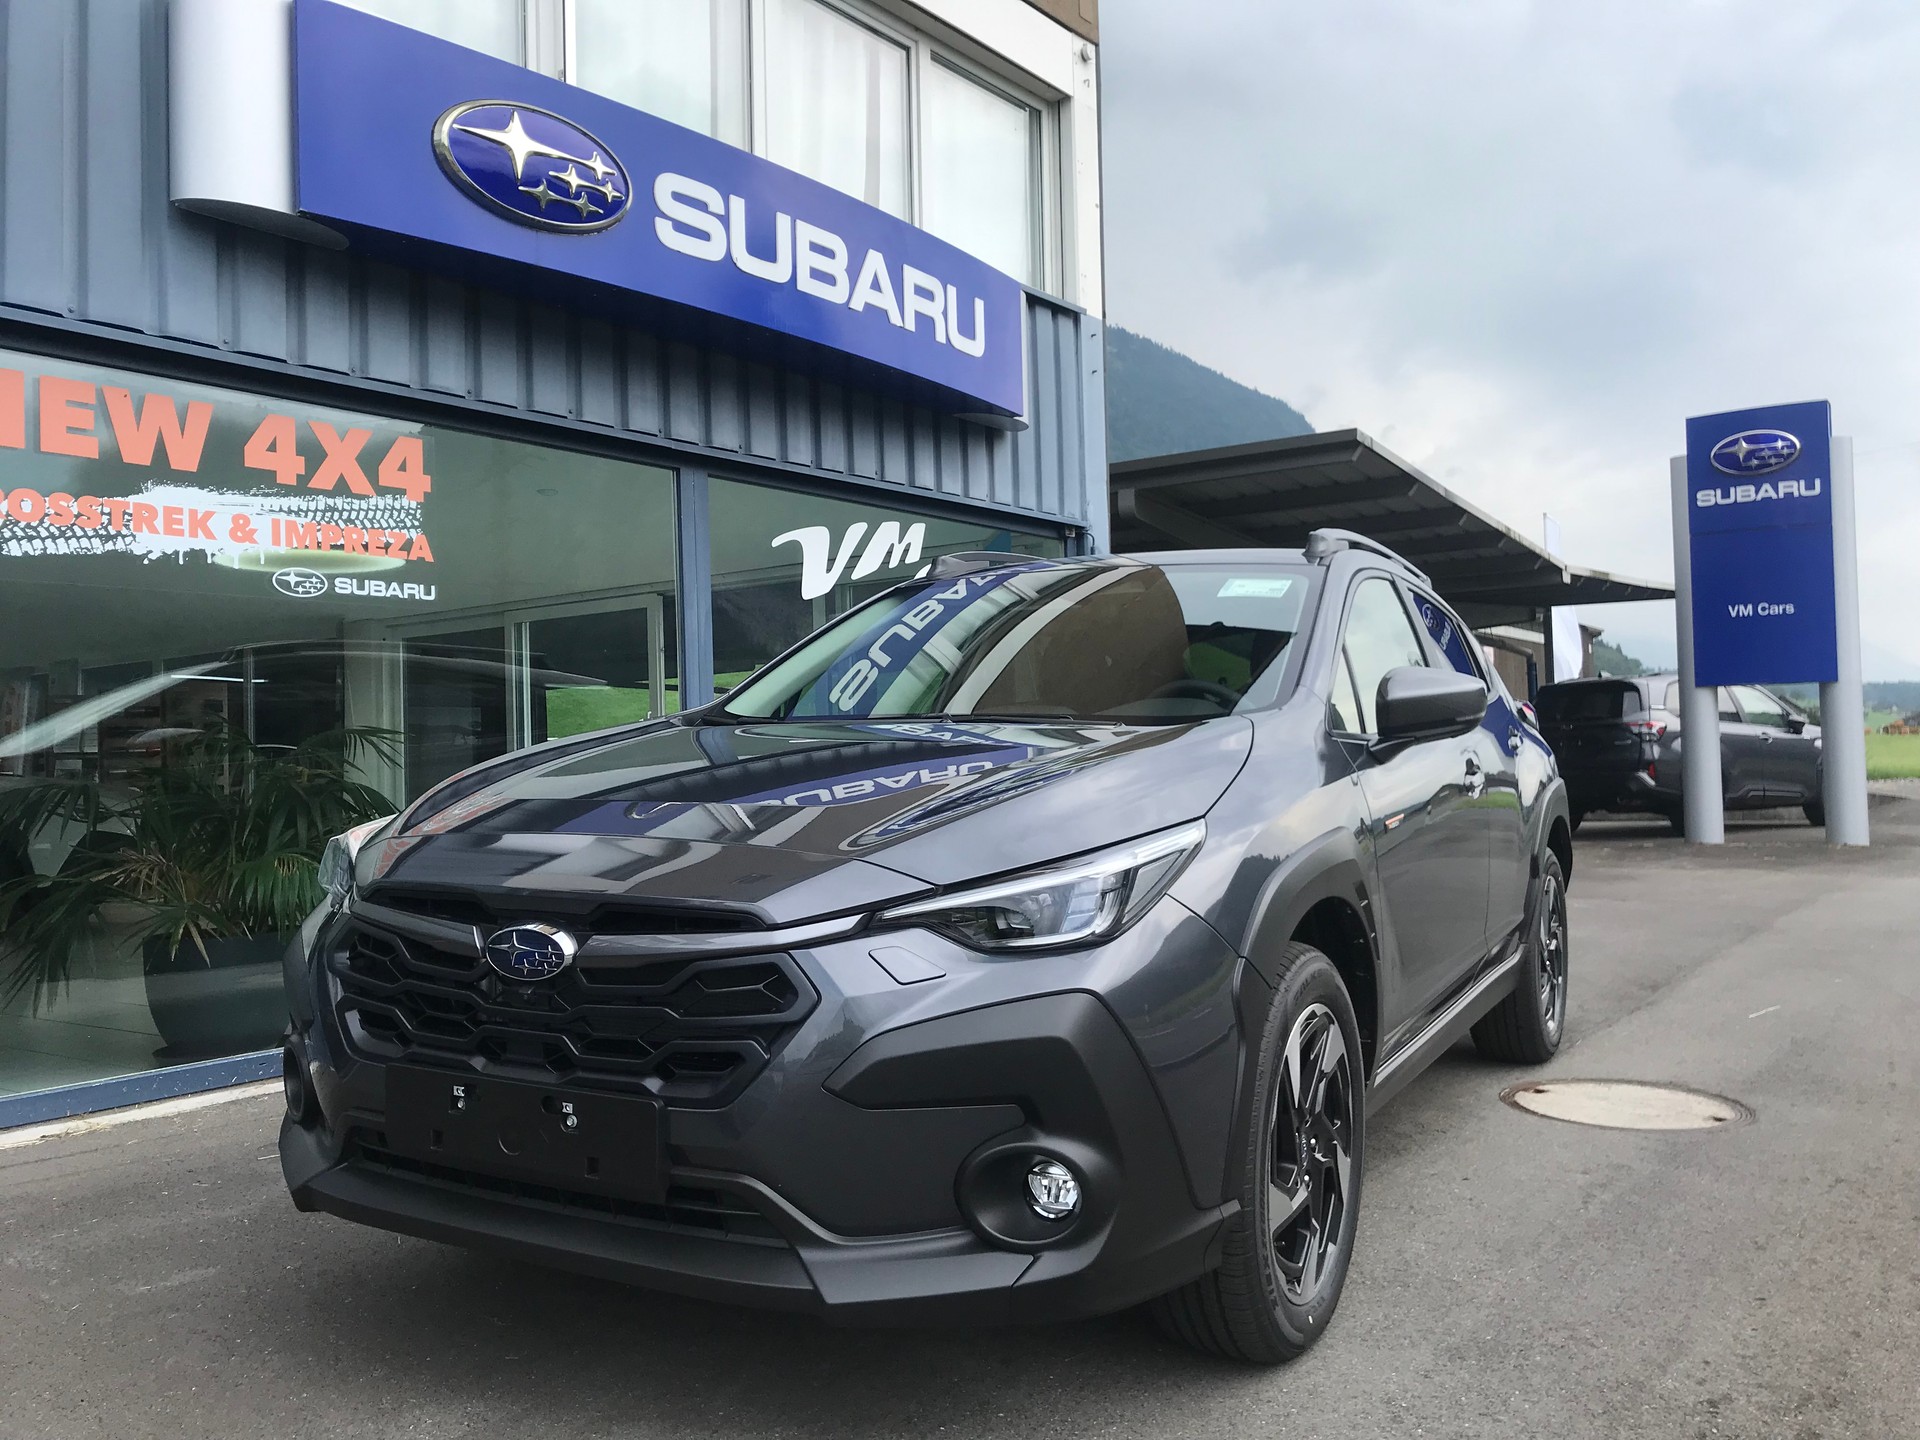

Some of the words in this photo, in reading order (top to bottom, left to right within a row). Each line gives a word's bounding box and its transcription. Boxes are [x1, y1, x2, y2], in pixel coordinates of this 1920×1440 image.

[653, 172, 985, 358] SUBARU
[243, 414, 431, 503] 4X4
[1696, 478, 1821, 508] SUBARU
[0, 488, 217, 541] OSSTREK
[228, 513, 259, 545] &
[271, 518, 435, 563] IMPREZA
[334, 577, 436, 601] SUBARU
[1728, 603, 1752, 618] VM
[1757, 601, 1795, 617] Cars
